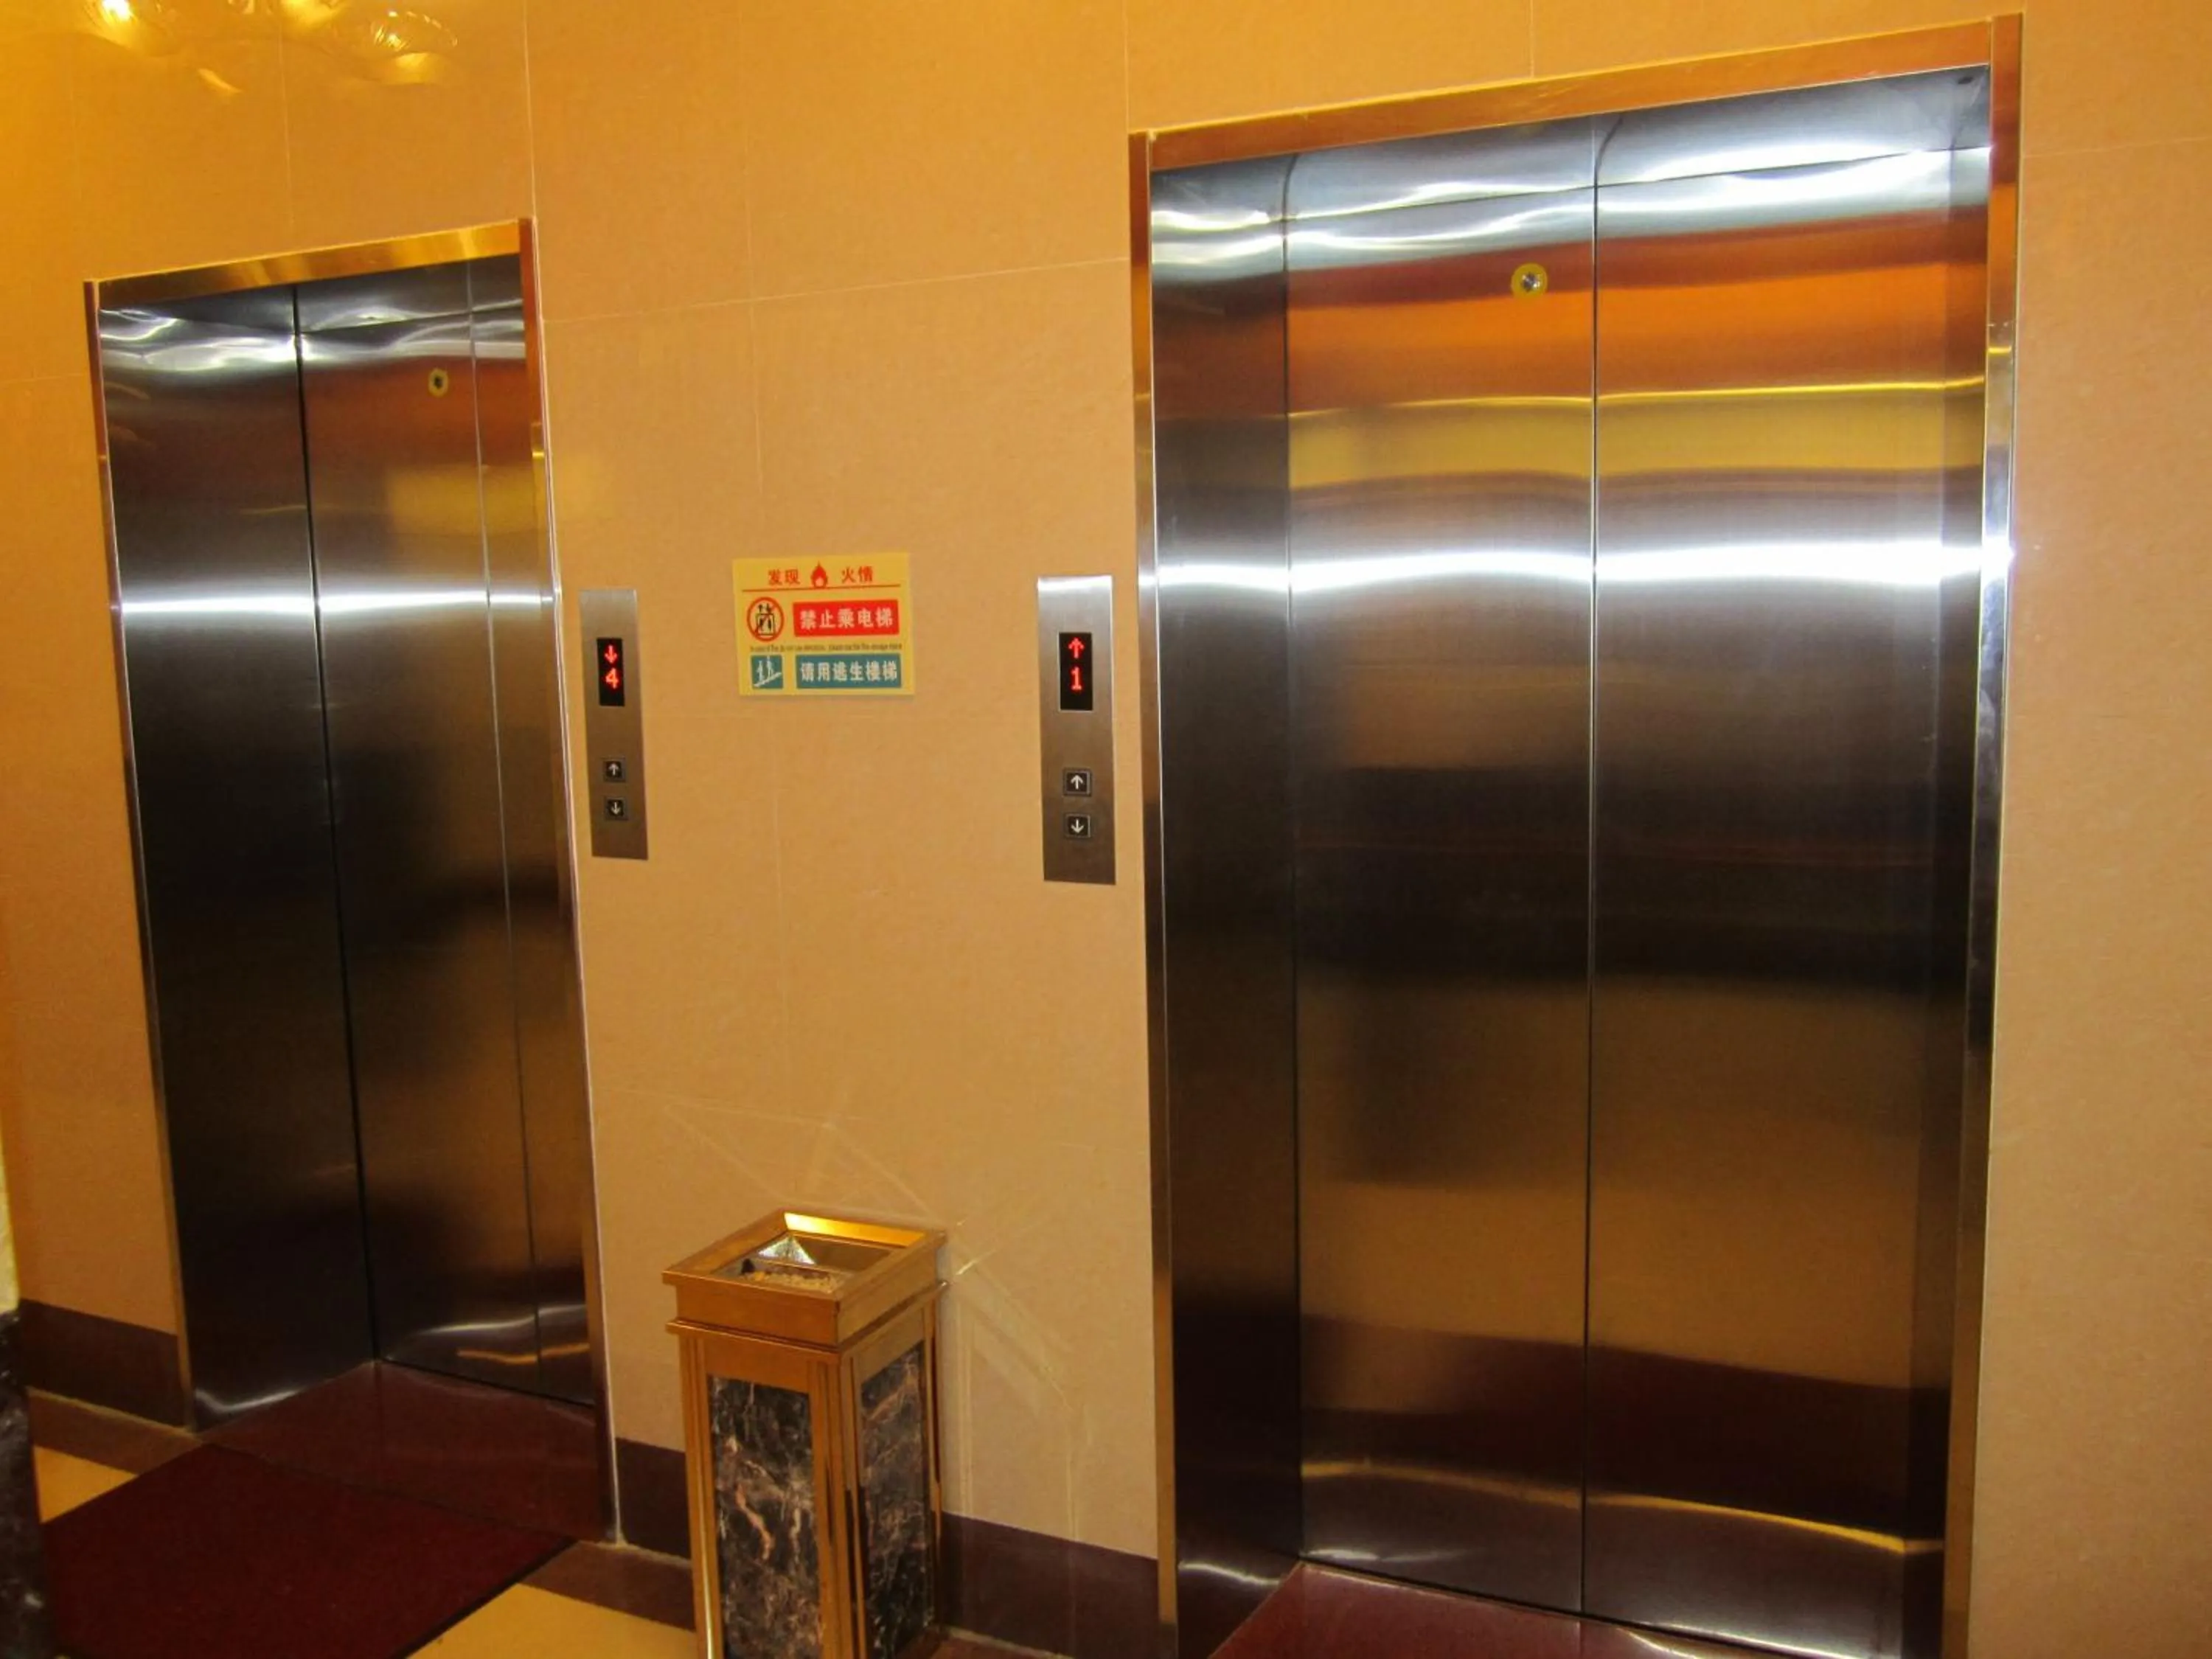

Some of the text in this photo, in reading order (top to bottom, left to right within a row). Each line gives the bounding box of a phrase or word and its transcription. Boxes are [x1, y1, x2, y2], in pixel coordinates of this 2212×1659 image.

[768, 566, 874, 585] 发现 火情
[800, 607, 893, 630] 禁止乘电梯
[605, 667, 619, 689] 4
[800, 661, 897, 682] 请用逃生楼梯
[1071, 667, 1082, 691] 1
